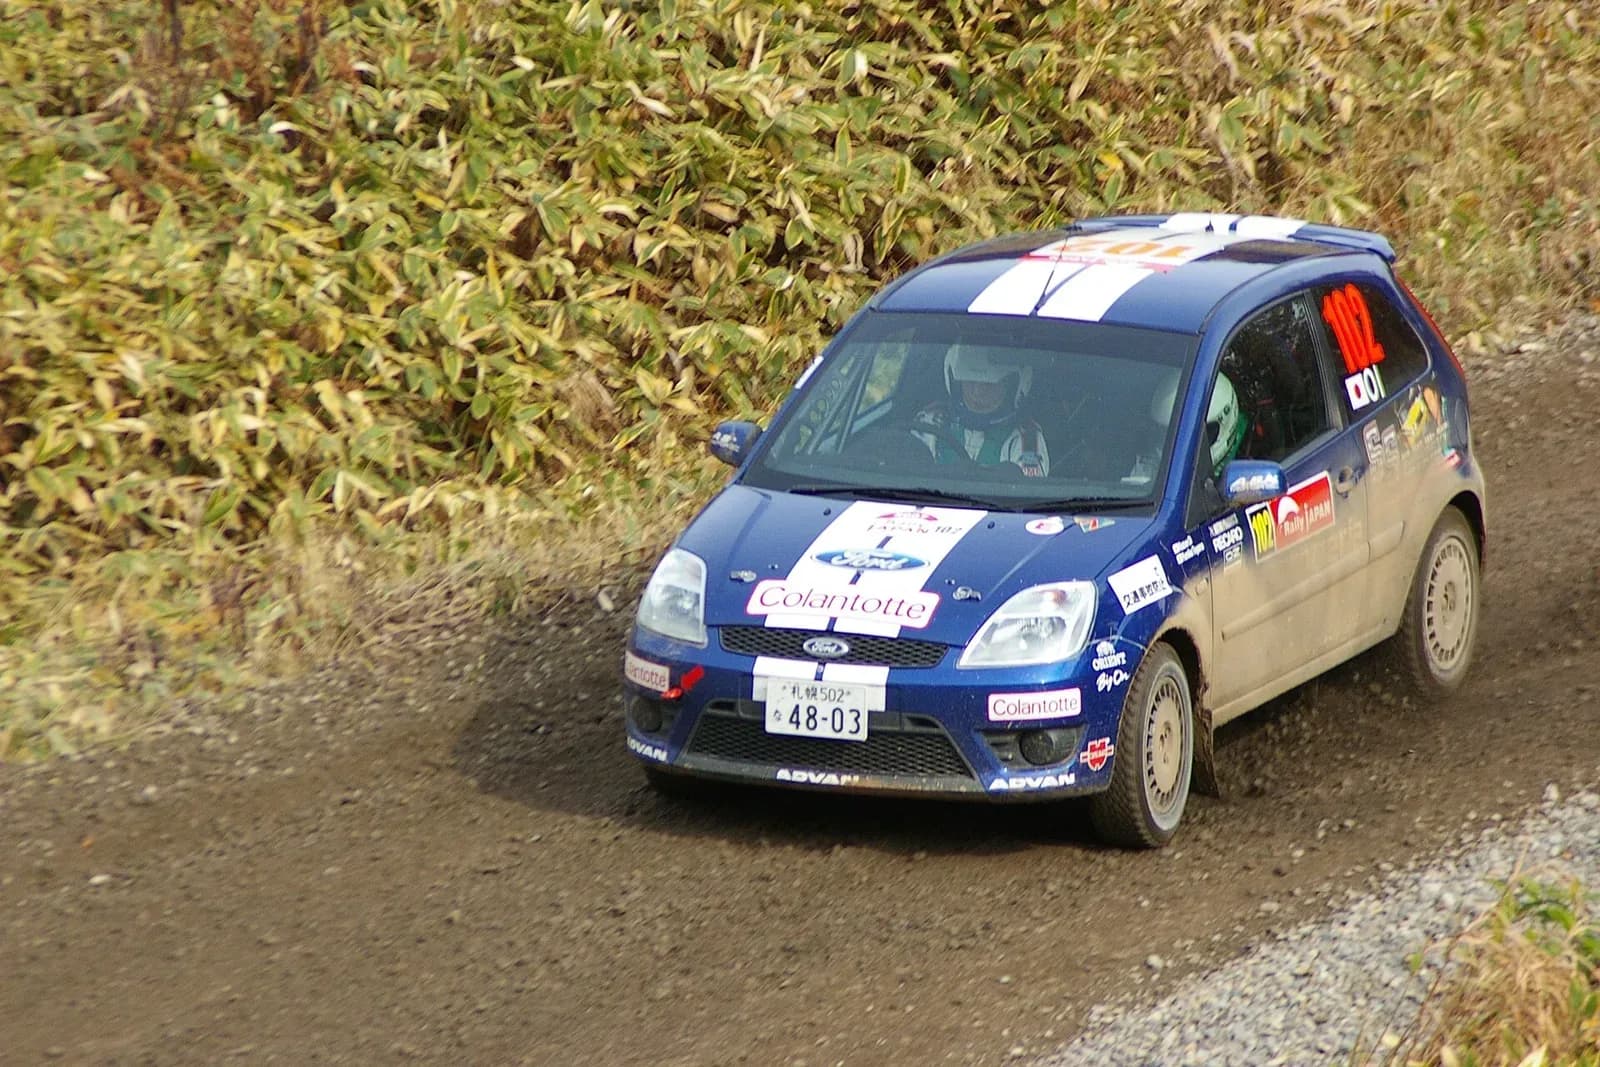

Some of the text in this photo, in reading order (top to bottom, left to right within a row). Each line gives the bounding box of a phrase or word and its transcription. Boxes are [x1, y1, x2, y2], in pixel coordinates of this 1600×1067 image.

[1321, 283, 1386, 374] 102
[1251, 509, 1274, 553] 102
[759, 586, 927, 620] Colantotte
[788, 703, 862, 735] 48-03
[993, 697, 1078, 717] Colantotte
[988, 772, 1076, 791] ADVAN
